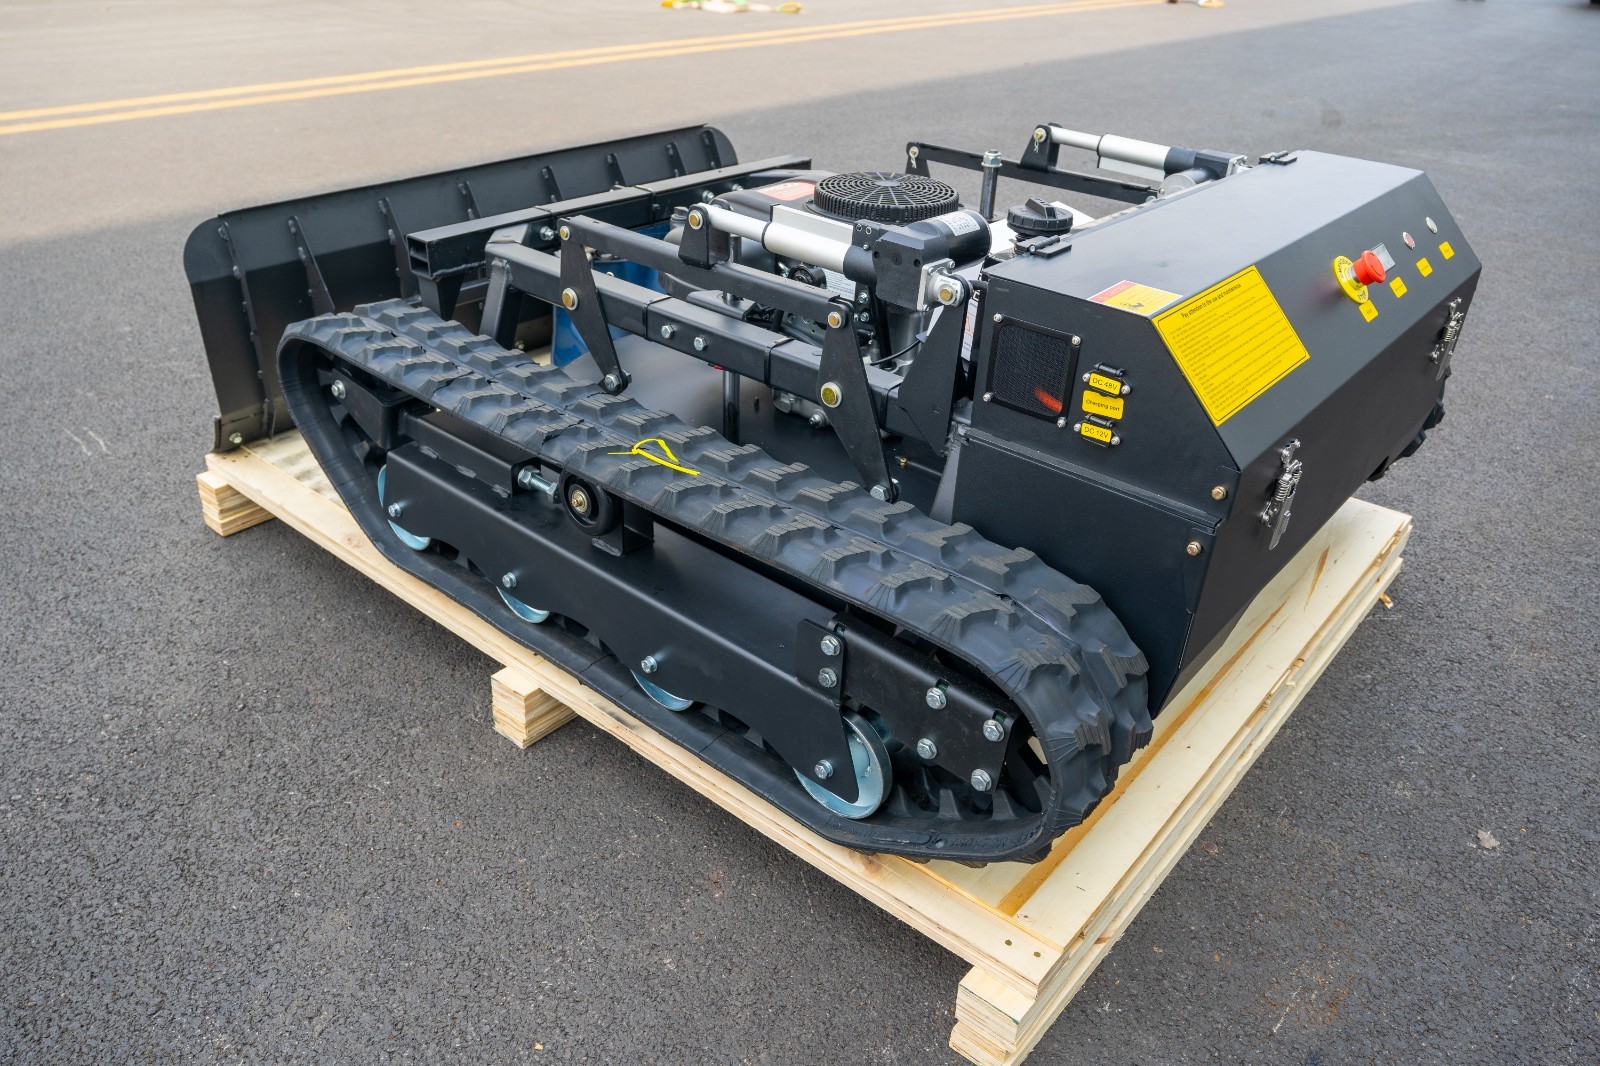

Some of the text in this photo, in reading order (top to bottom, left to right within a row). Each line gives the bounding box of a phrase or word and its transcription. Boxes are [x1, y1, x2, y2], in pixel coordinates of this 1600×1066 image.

[1188, 305, 1203, 315] attention
[1093, 378, 1117, 390] DC 48V
[1086, 400, 1108, 409] Charging
[1084, 426, 1109, 438] DC 12V
